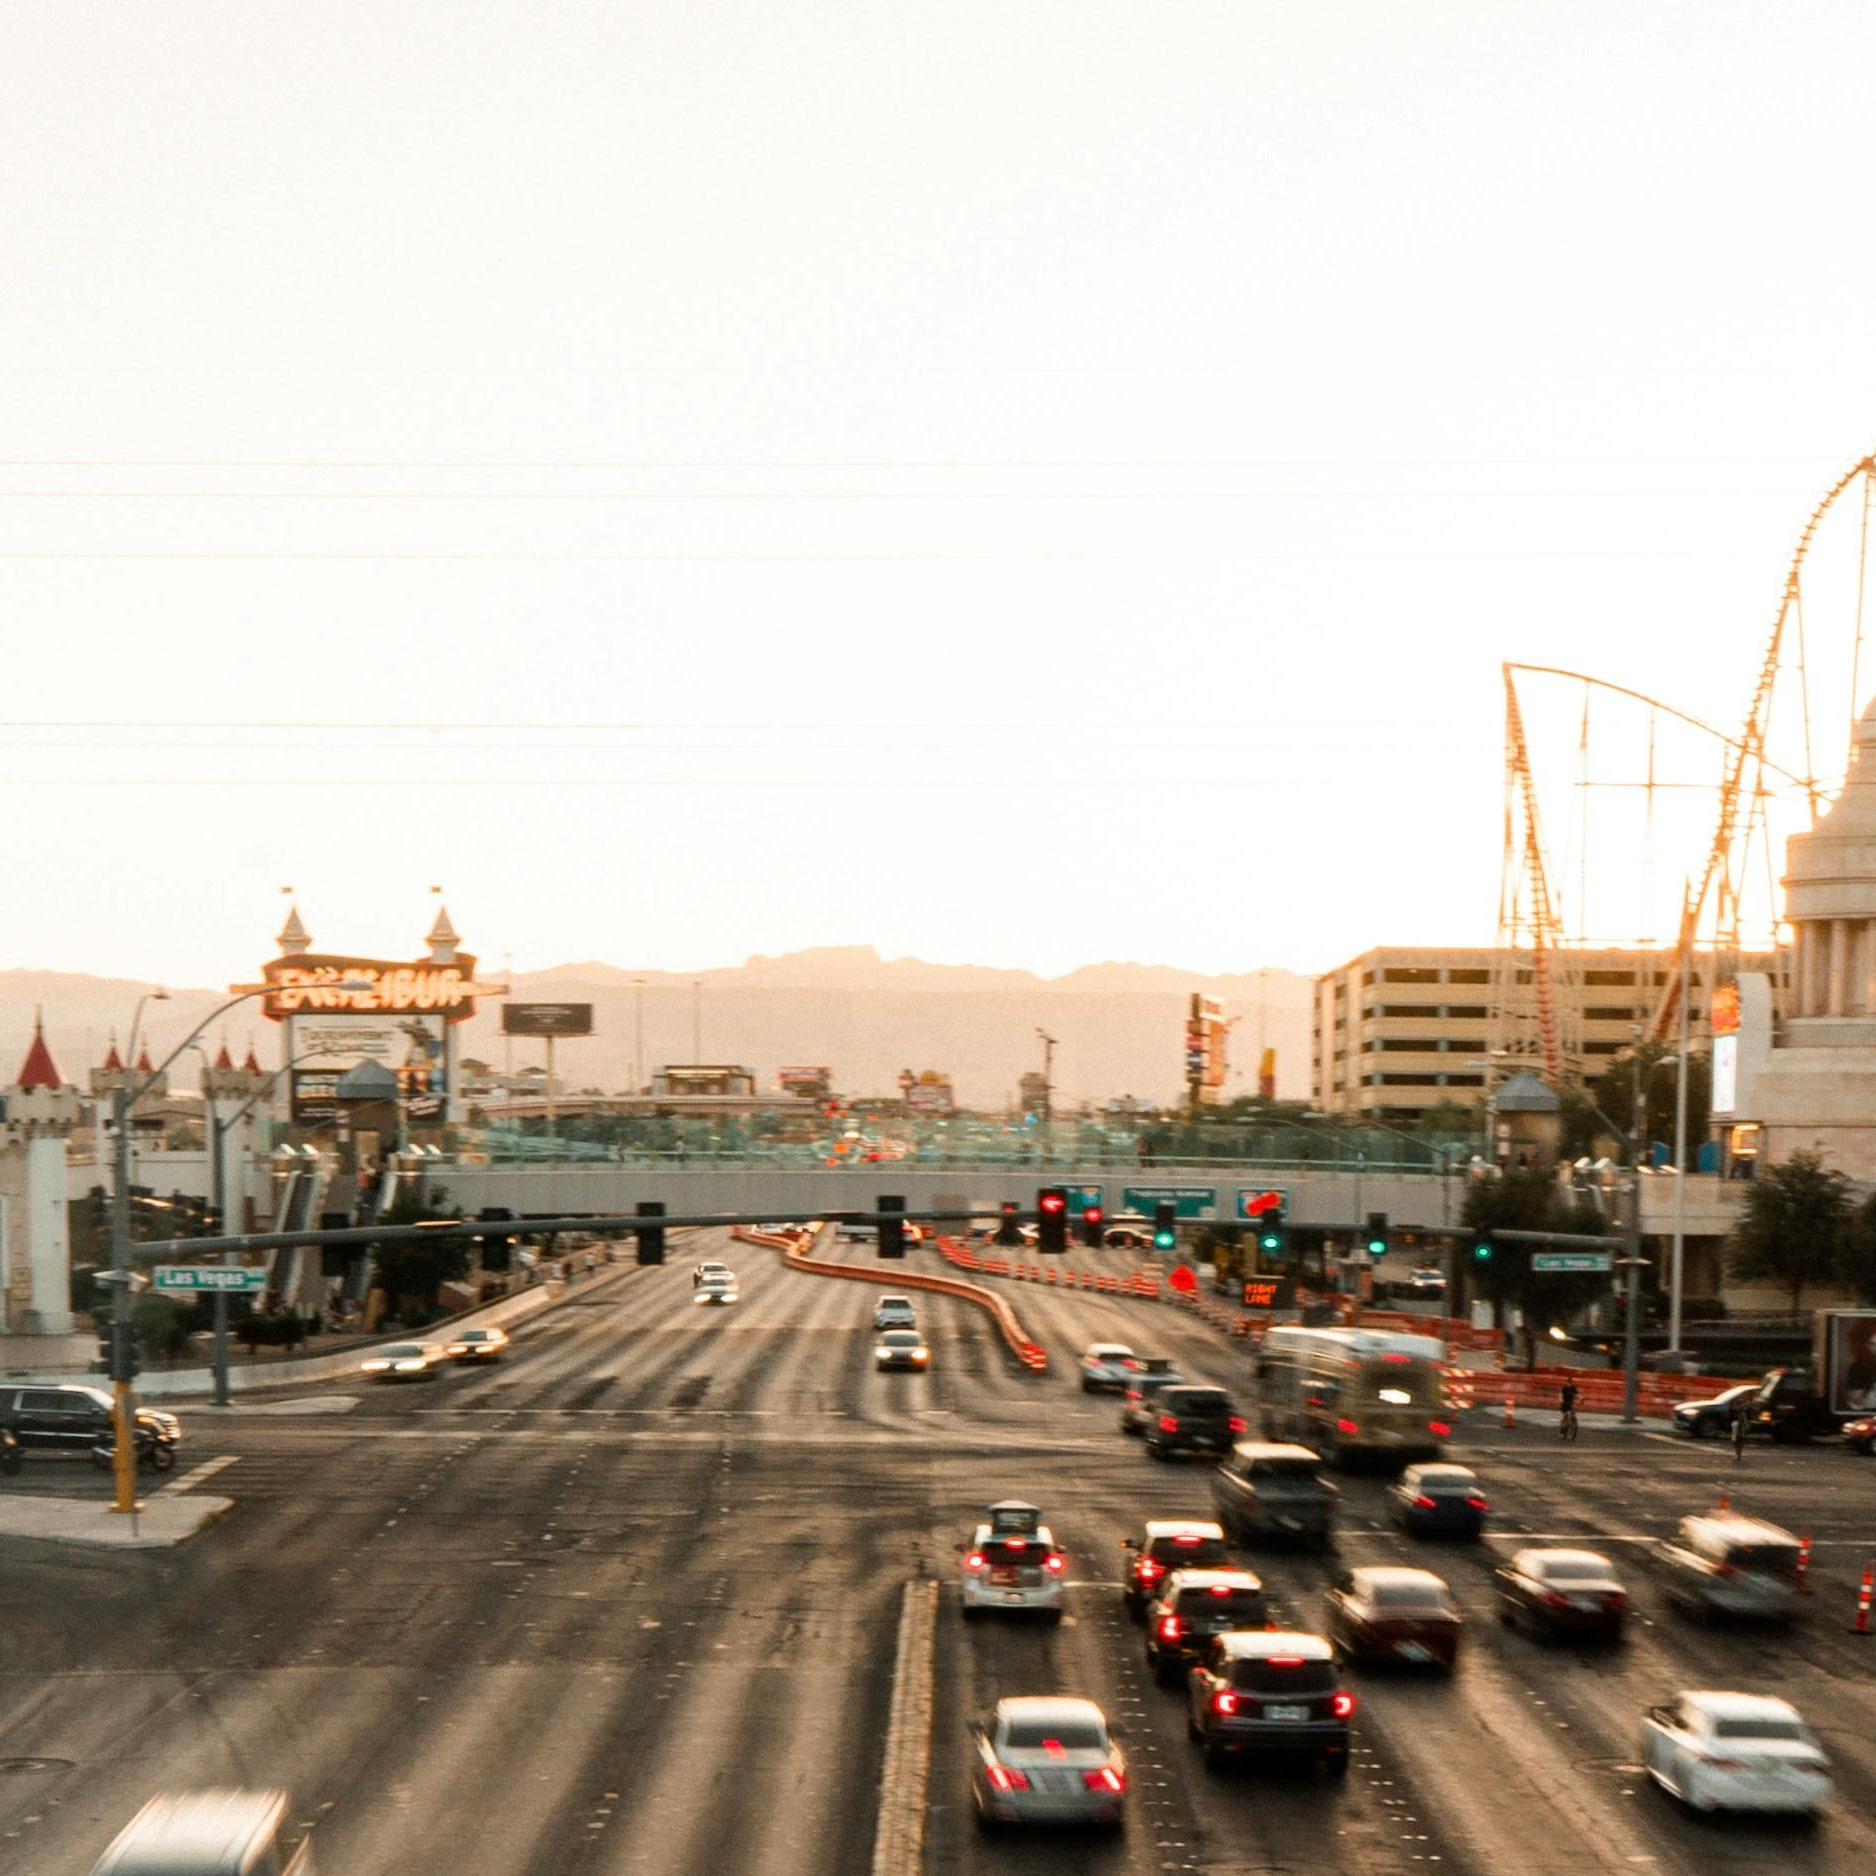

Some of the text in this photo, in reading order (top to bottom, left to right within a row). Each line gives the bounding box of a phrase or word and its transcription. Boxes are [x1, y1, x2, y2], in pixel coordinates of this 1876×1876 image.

[164, 1270, 194, 1285] Las
[197, 1270, 244, 1289] Vegas
[1244, 1283, 1277, 1294] RIGHT
